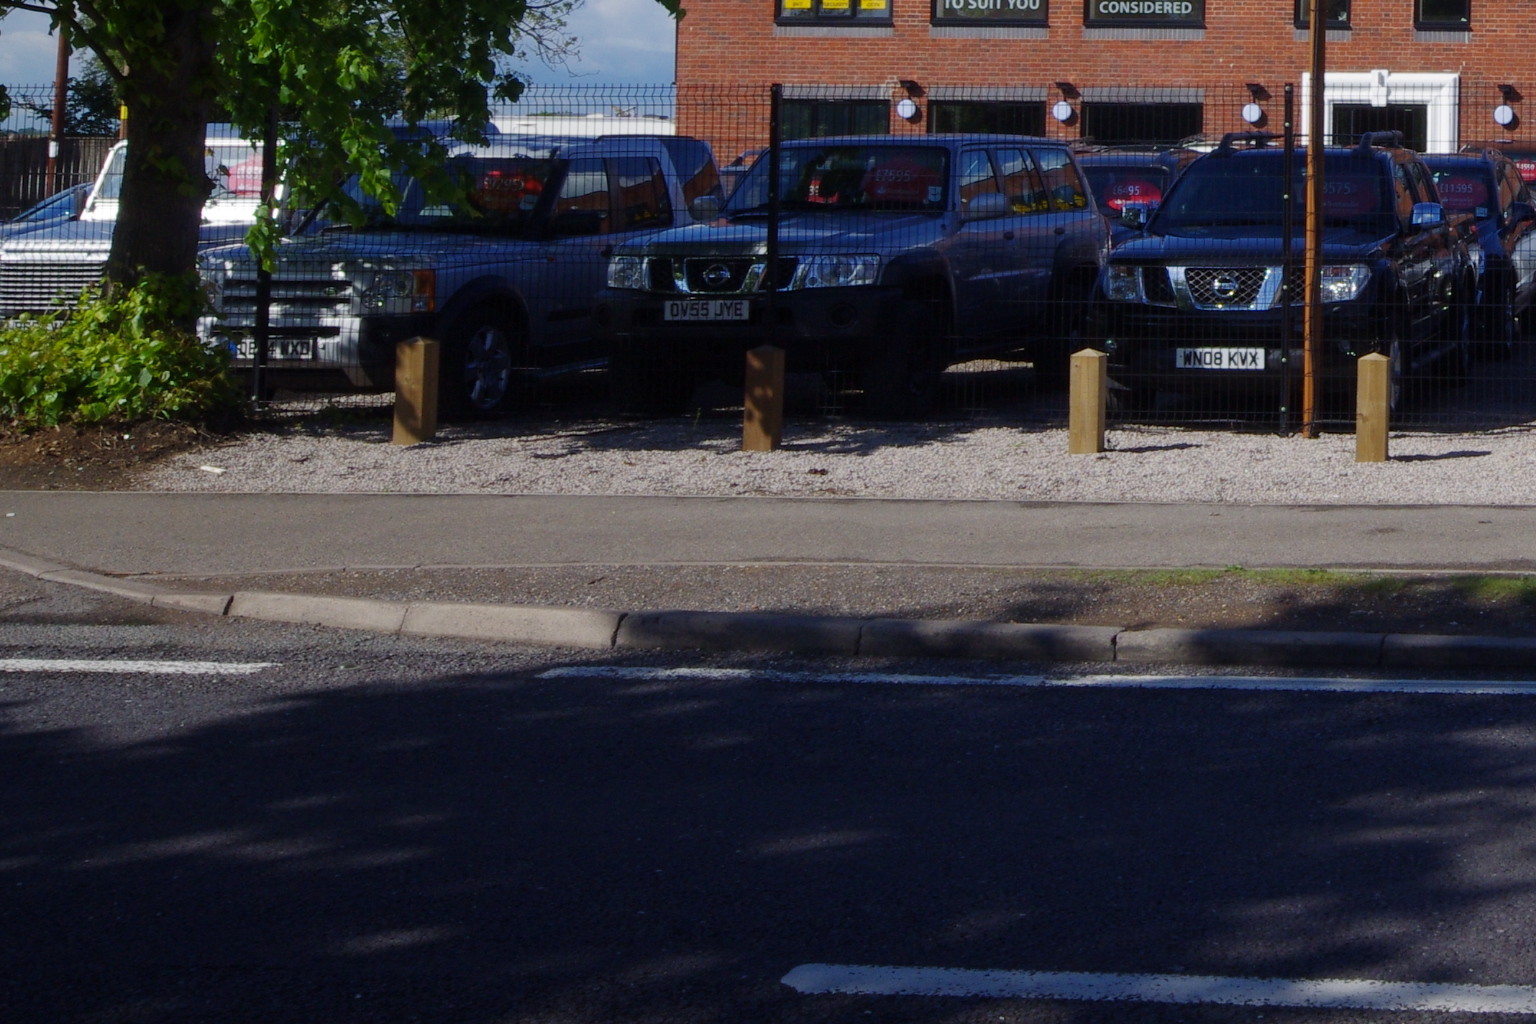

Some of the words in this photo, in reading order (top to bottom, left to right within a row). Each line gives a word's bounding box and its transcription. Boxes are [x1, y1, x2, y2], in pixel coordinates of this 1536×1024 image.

[1099, 1, 1192, 14] CONSIDERED
[715, 302, 743, 317] JYE
[1228, 351, 1258, 366] KVX
